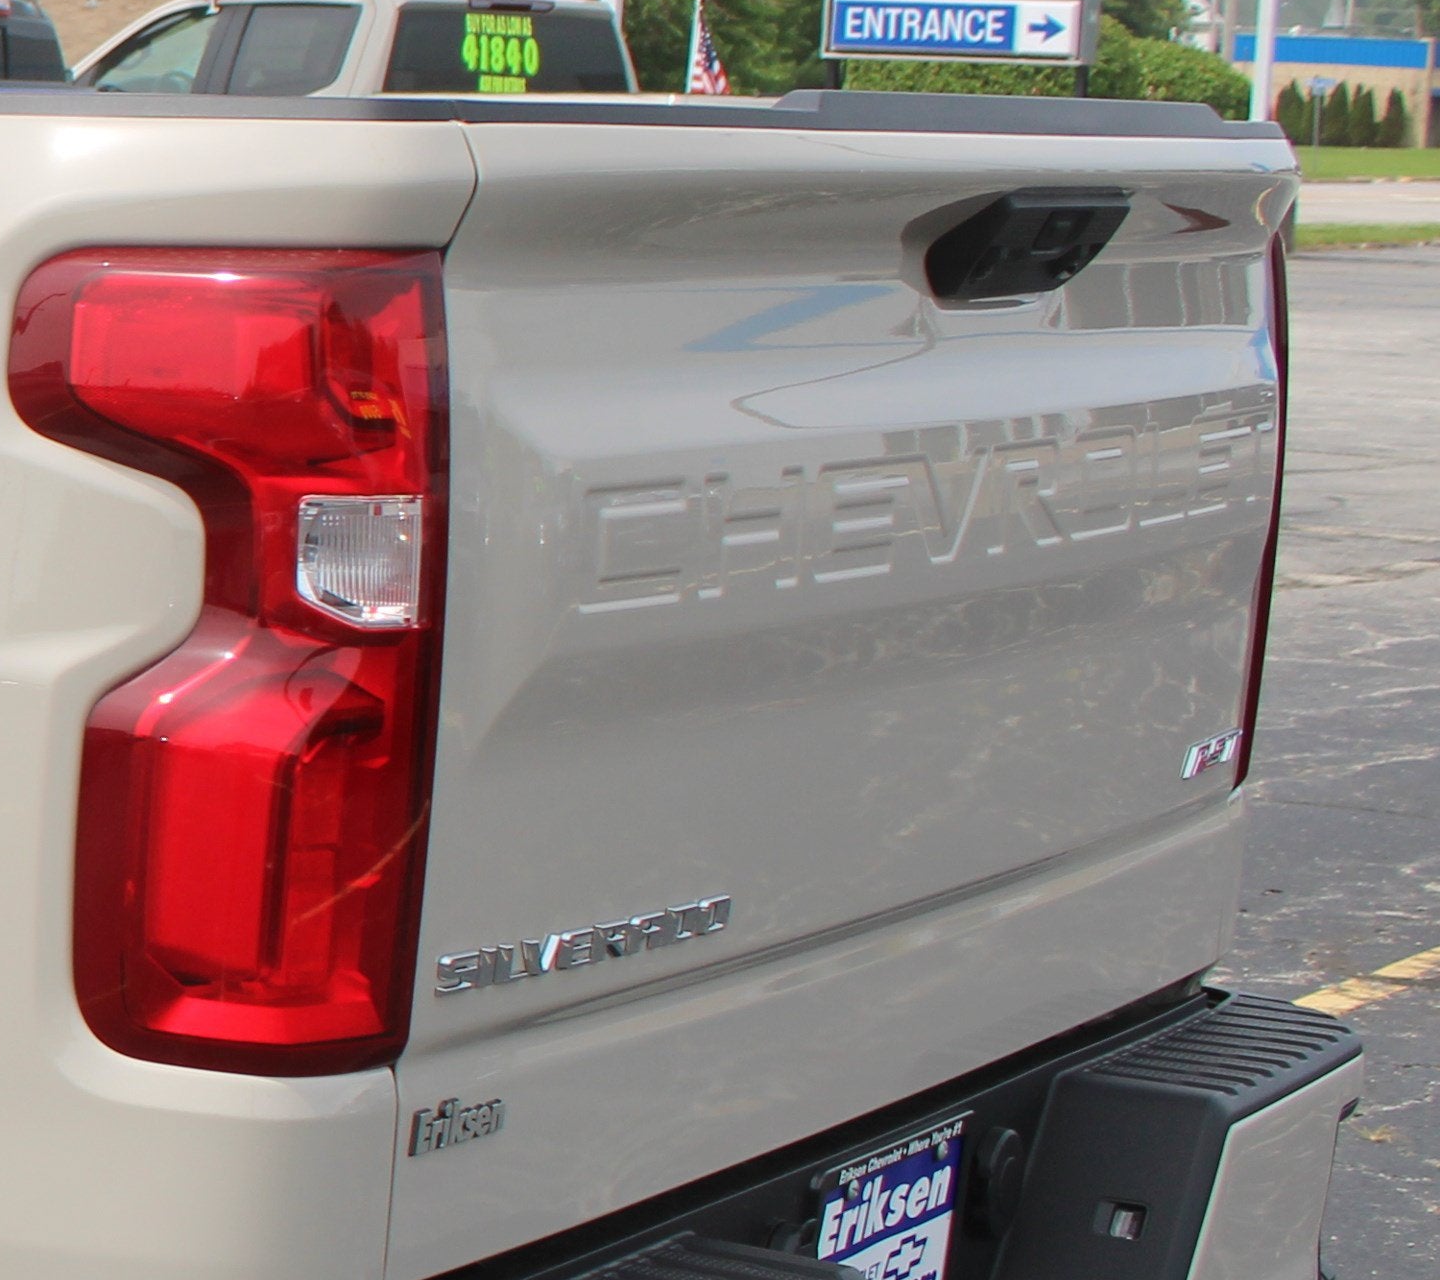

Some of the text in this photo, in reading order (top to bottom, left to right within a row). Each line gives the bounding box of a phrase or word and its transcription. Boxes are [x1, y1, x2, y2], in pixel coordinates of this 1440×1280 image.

[463, 33, 539, 76] 41840
[844, 5, 1008, 44] ENTRANCE
[578, 402, 1275, 614] CHEVROLET
[434, 891, 731, 998] SILVERADO
[408, 1098, 505, 1157] Eriksen
[817, 1164, 952, 1261] Eriksen
